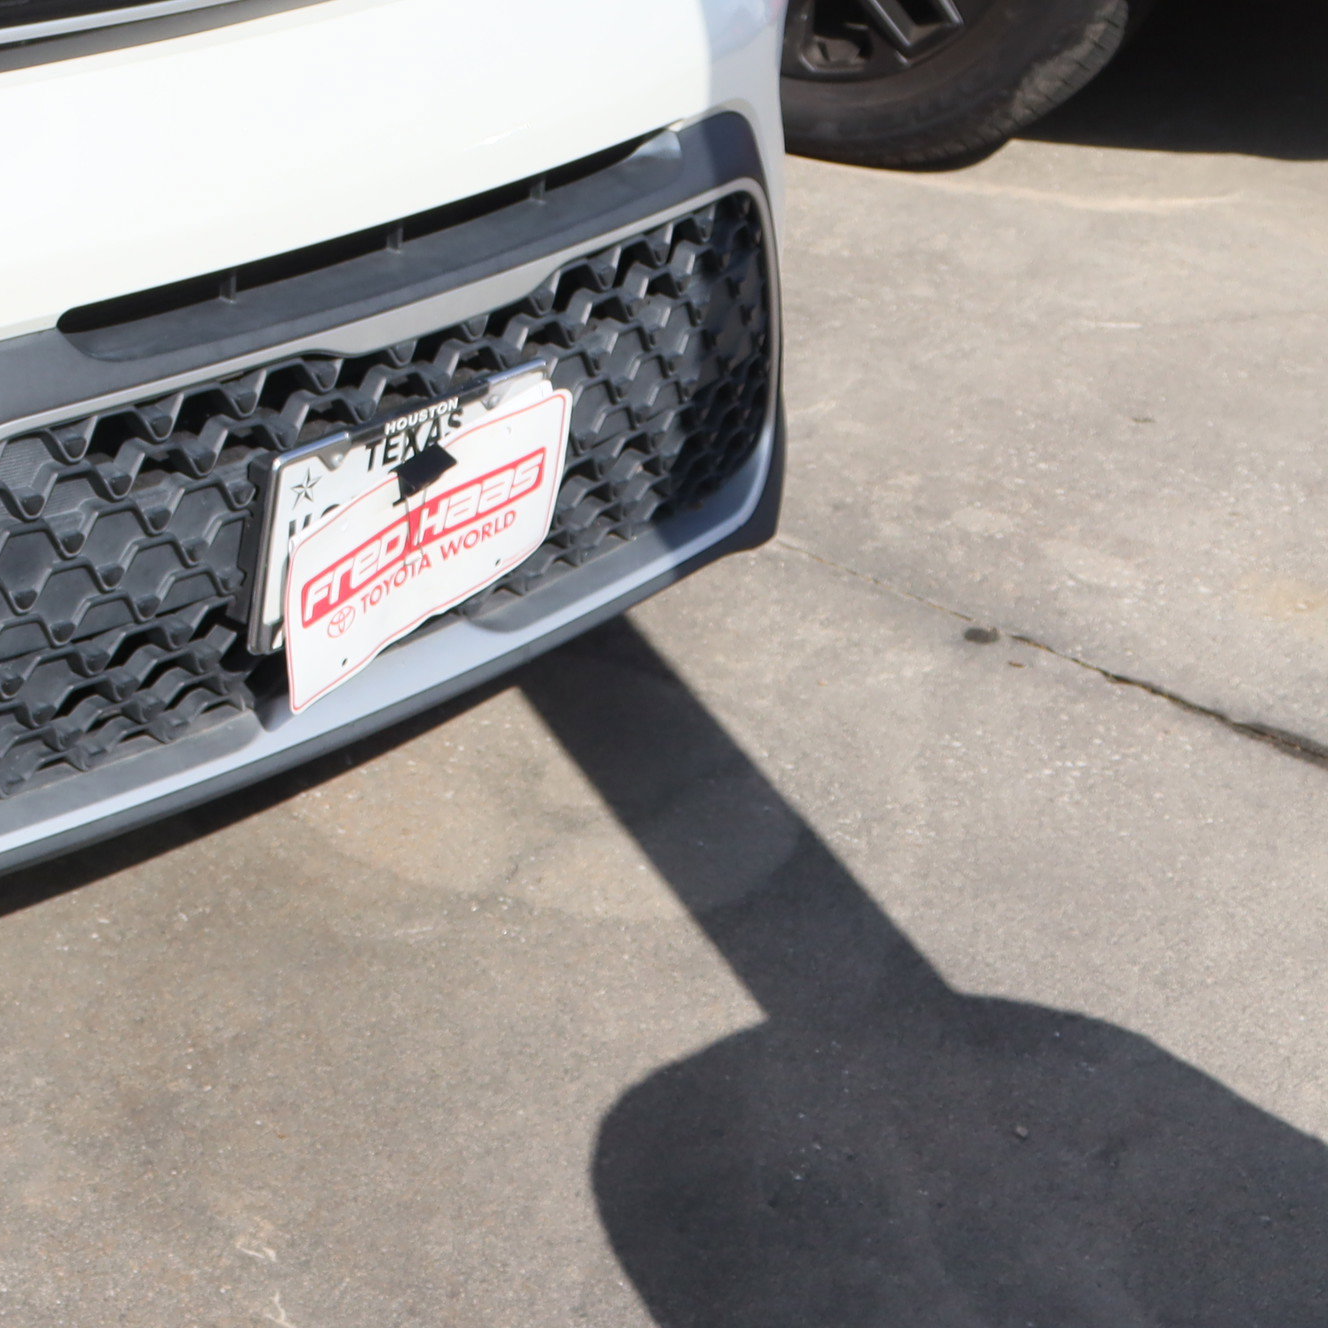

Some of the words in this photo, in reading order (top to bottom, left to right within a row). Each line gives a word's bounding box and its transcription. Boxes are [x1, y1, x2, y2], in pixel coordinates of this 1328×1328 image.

[365, 407, 464, 472] TEXAS
[384, 397, 459, 436] HOUSTON
[361, 553, 432, 613] TOYOTA
[440, 510, 517, 560] WORLD
